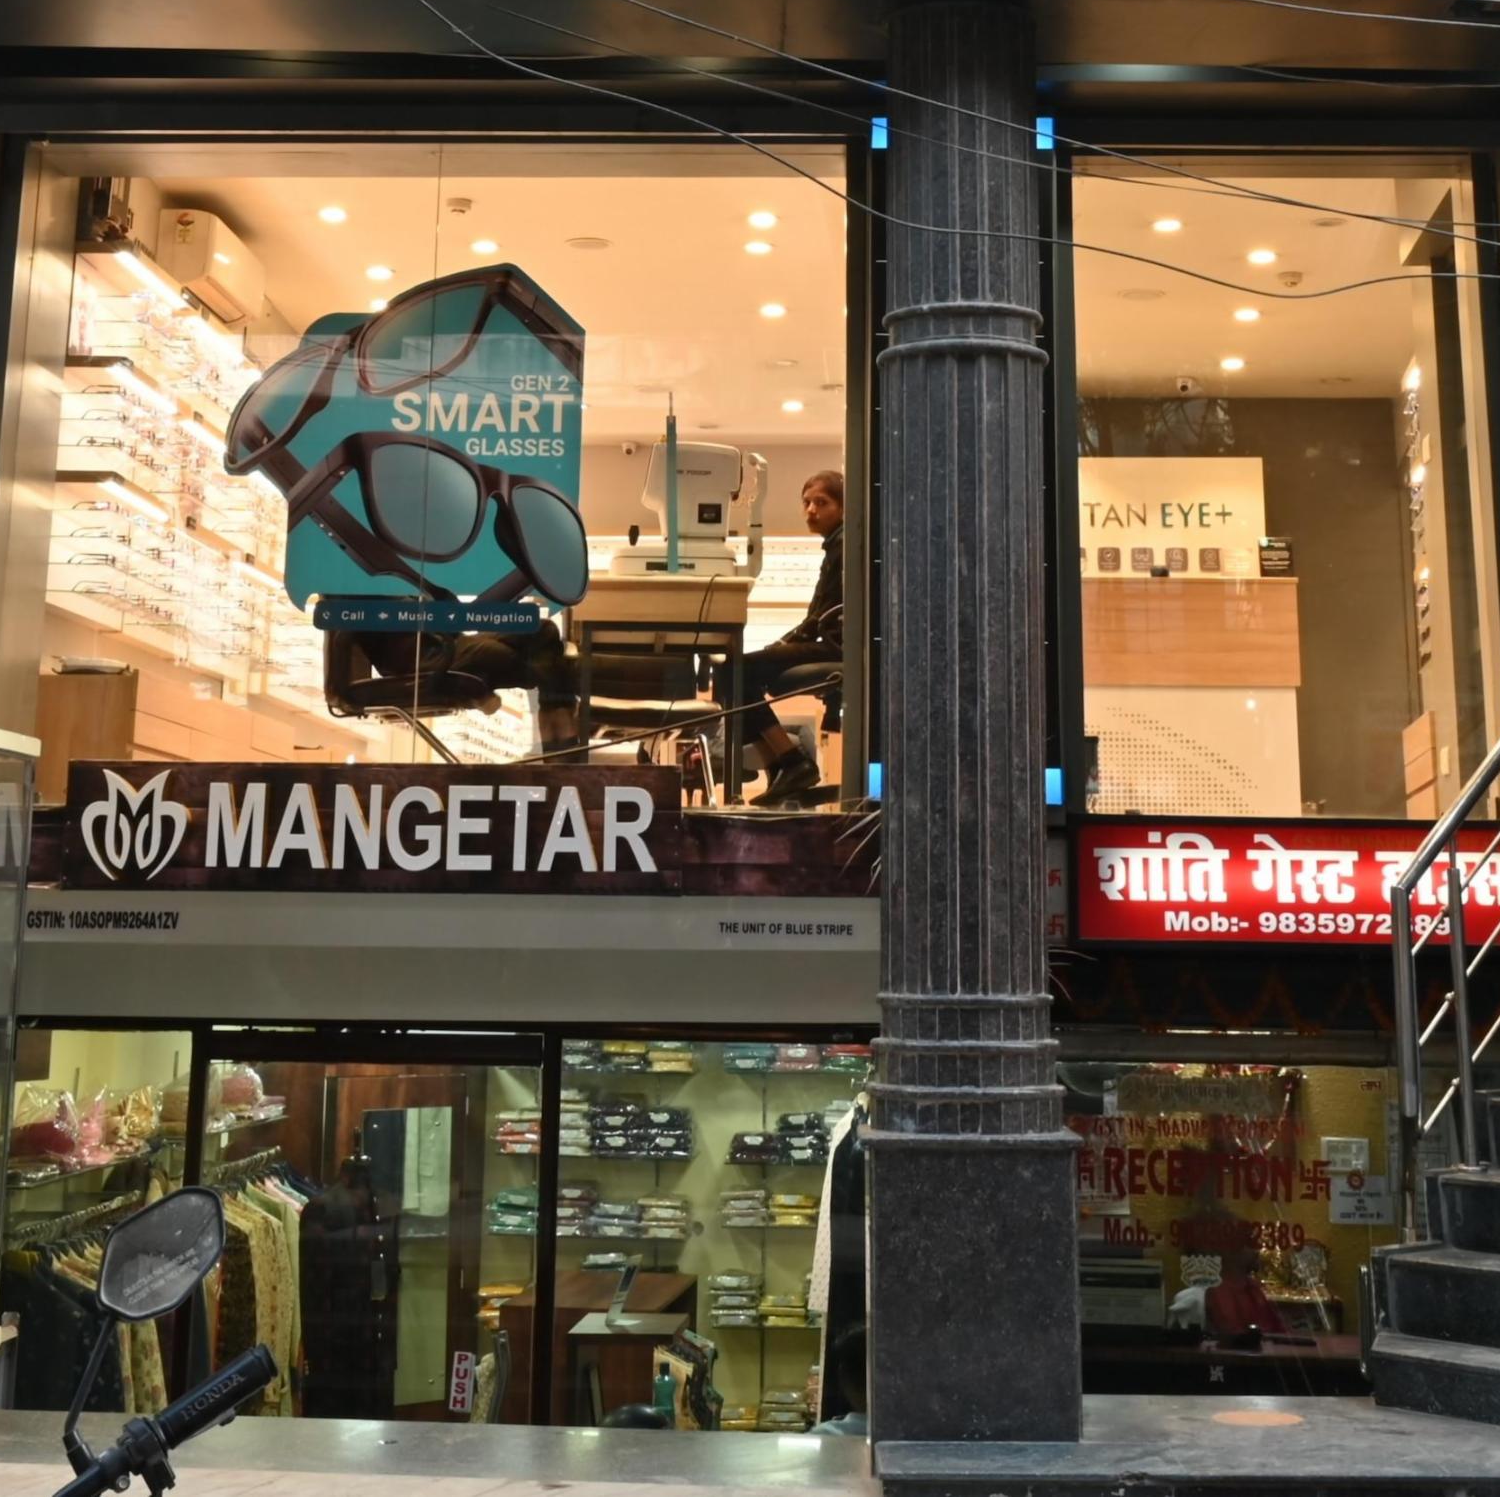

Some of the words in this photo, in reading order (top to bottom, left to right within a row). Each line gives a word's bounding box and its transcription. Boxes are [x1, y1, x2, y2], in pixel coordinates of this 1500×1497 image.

[510, 374, 551, 392] GEN
[557, 375, 570, 392] 2
[390, 391, 575, 434] SMART
[465, 437, 565, 458] GLASSES
[1083, 503, 1147, 528] TAN
[341, 610, 365, 621] Call
[397, 610, 435, 622] Music
[466, 611, 533, 626] Navigation
[204, 780, 660, 874] MANGETAR
[1093, 831, 1230, 903] शांति
[1246, 834, 1360, 905] गेस्ट
[26, 910, 65, 929] GSTIN:
[719, 921, 739, 934] THE
[742, 922, 766, 934] UNIT
[769, 922, 783, 934] OF
[785, 923, 813, 935] BLUE
[816, 924, 853, 936] STRIPE
[1258, 911, 1451, 936] 983597289
[452, 1353, 469, 1408] PUSH
[180, 1373, 246, 1421] HONDA
